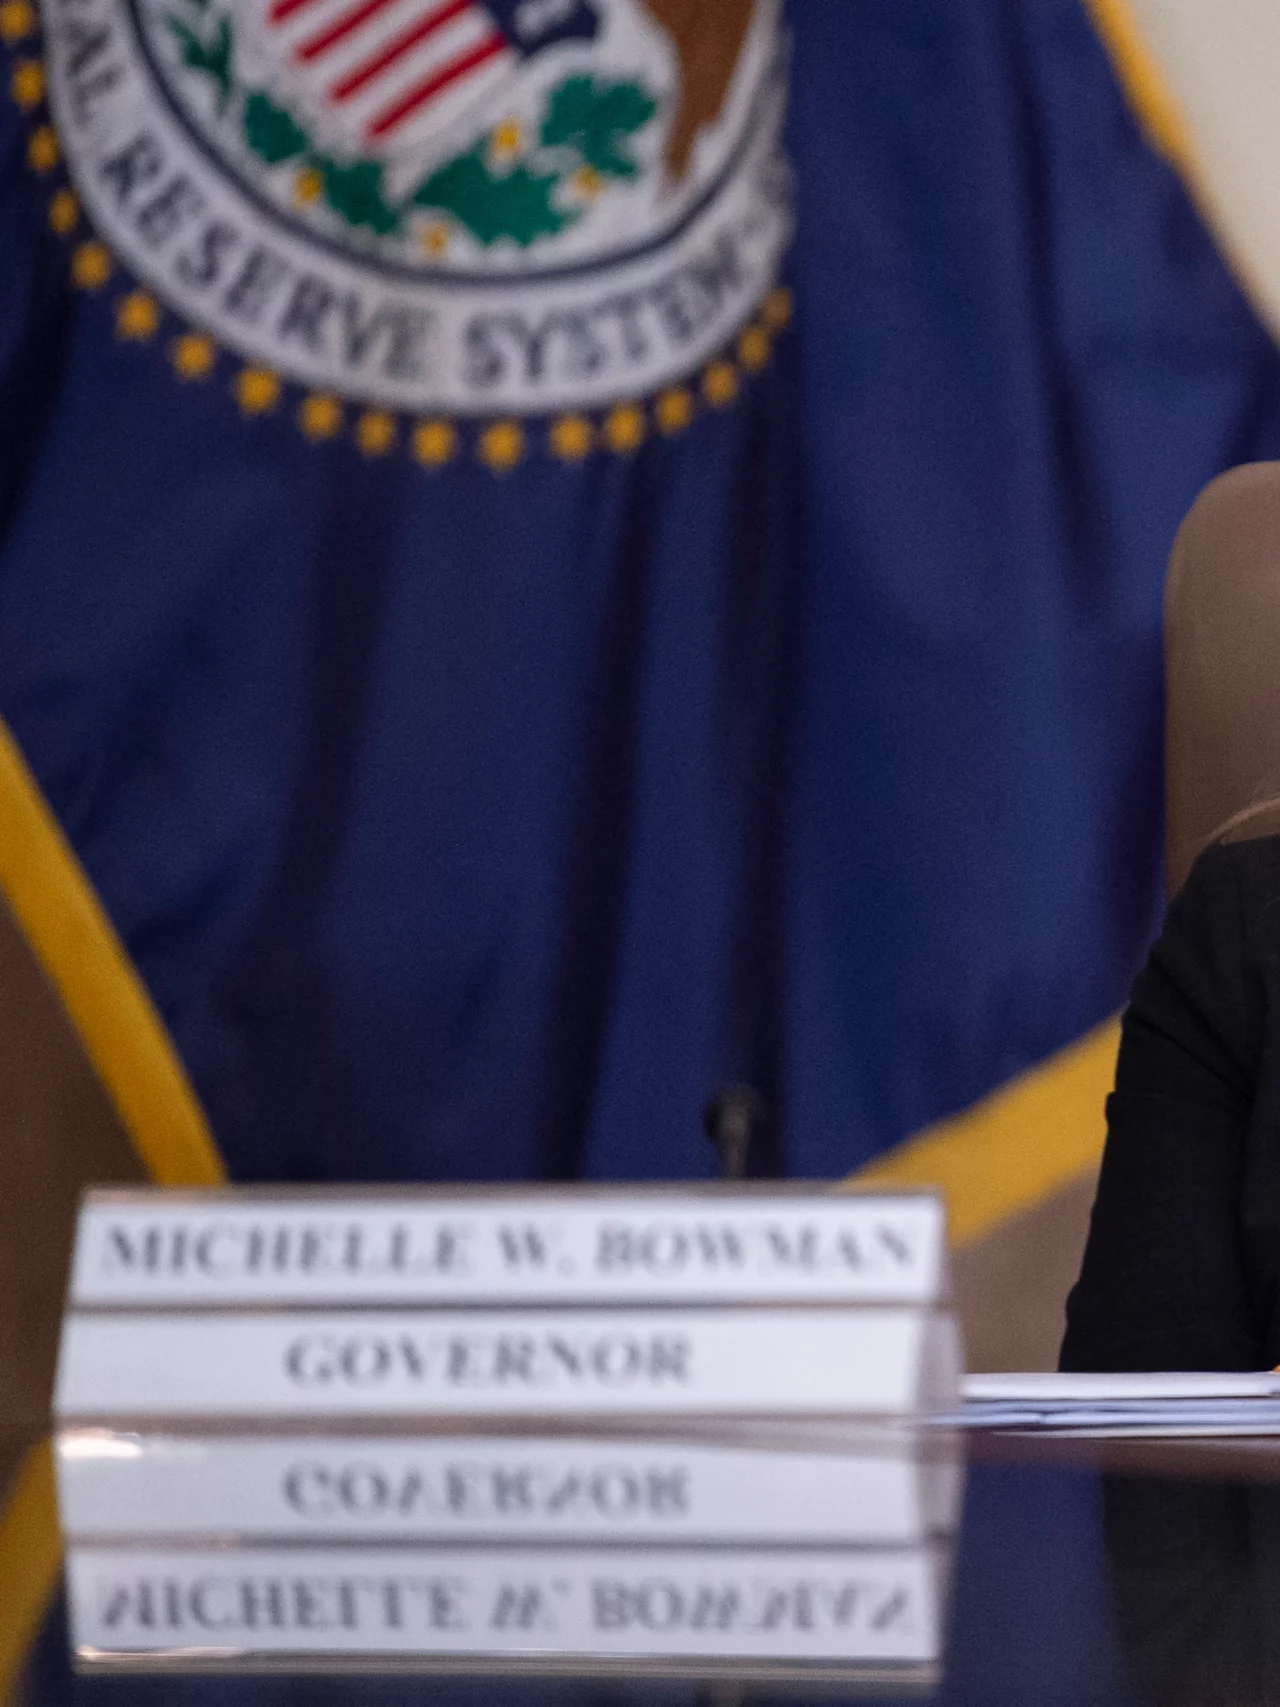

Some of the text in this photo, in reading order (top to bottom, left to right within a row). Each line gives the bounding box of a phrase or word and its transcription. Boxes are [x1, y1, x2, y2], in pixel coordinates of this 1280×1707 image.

[98, 130, 443, 385] RESERVE
[460, 225, 748, 391] SYSTEM
[102, 1221, 916, 1277] MICHELLE W. BOWMAN
[284, 1332, 693, 1389] GOVERNOR
